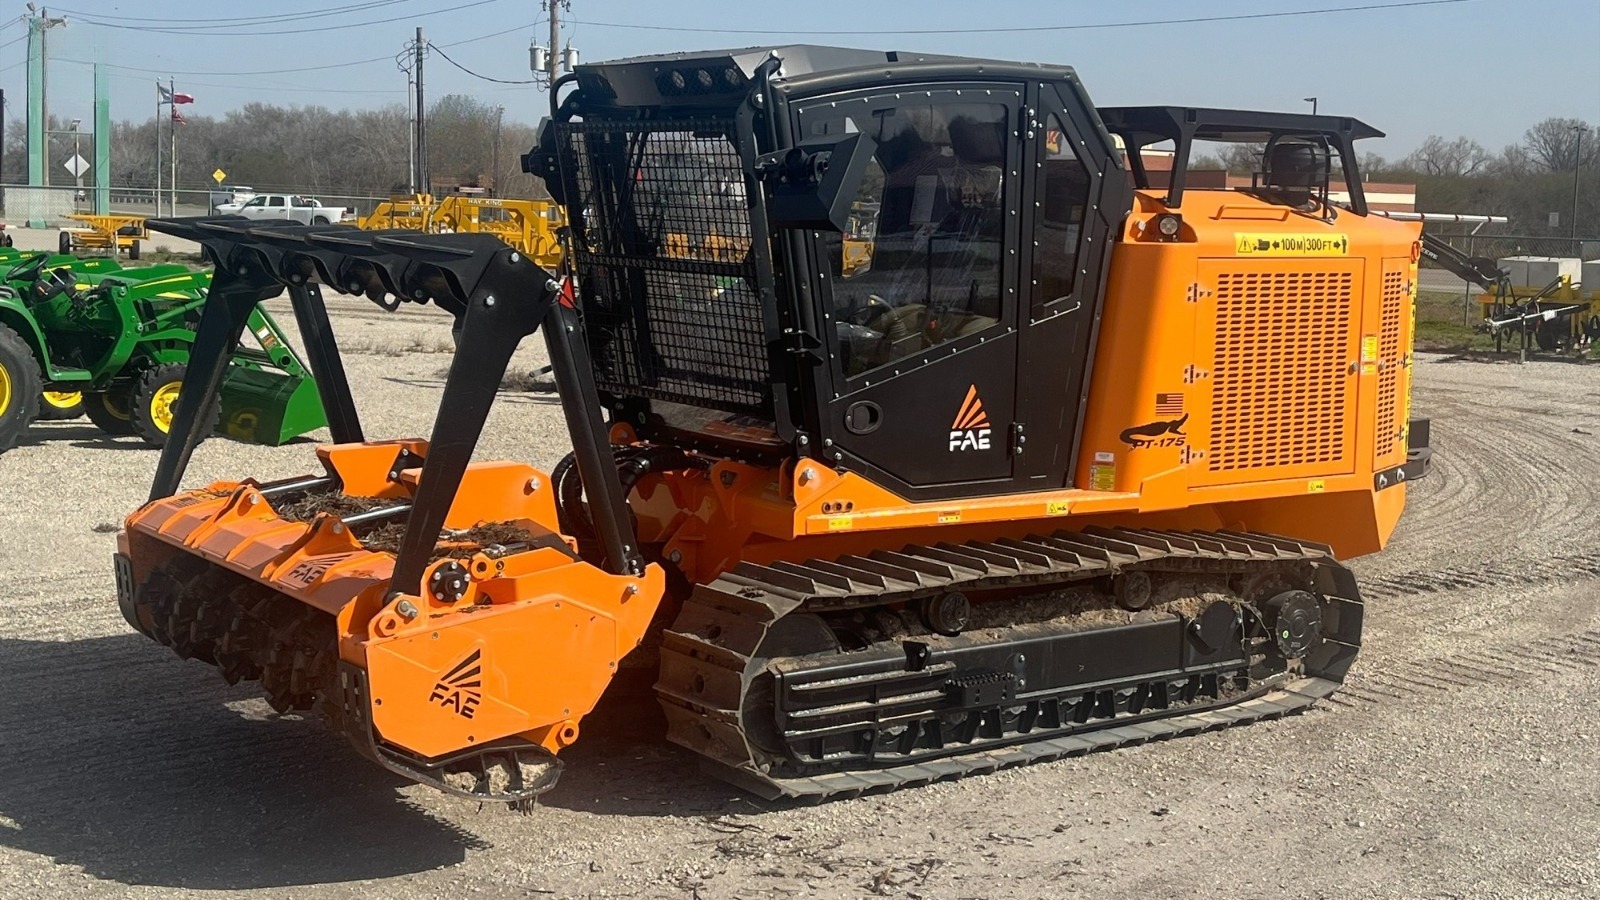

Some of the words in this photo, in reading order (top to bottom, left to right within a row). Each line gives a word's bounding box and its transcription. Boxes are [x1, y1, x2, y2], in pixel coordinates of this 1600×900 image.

[1281, 238, 1303, 251] 100M
[1306, 238, 1332, 251] 300FT
[949, 428, 992, 452] FAE
[1132, 436, 1187, 449] PT-175
[288, 563, 322, 584] FAE
[429, 683, 480, 719] FAE
